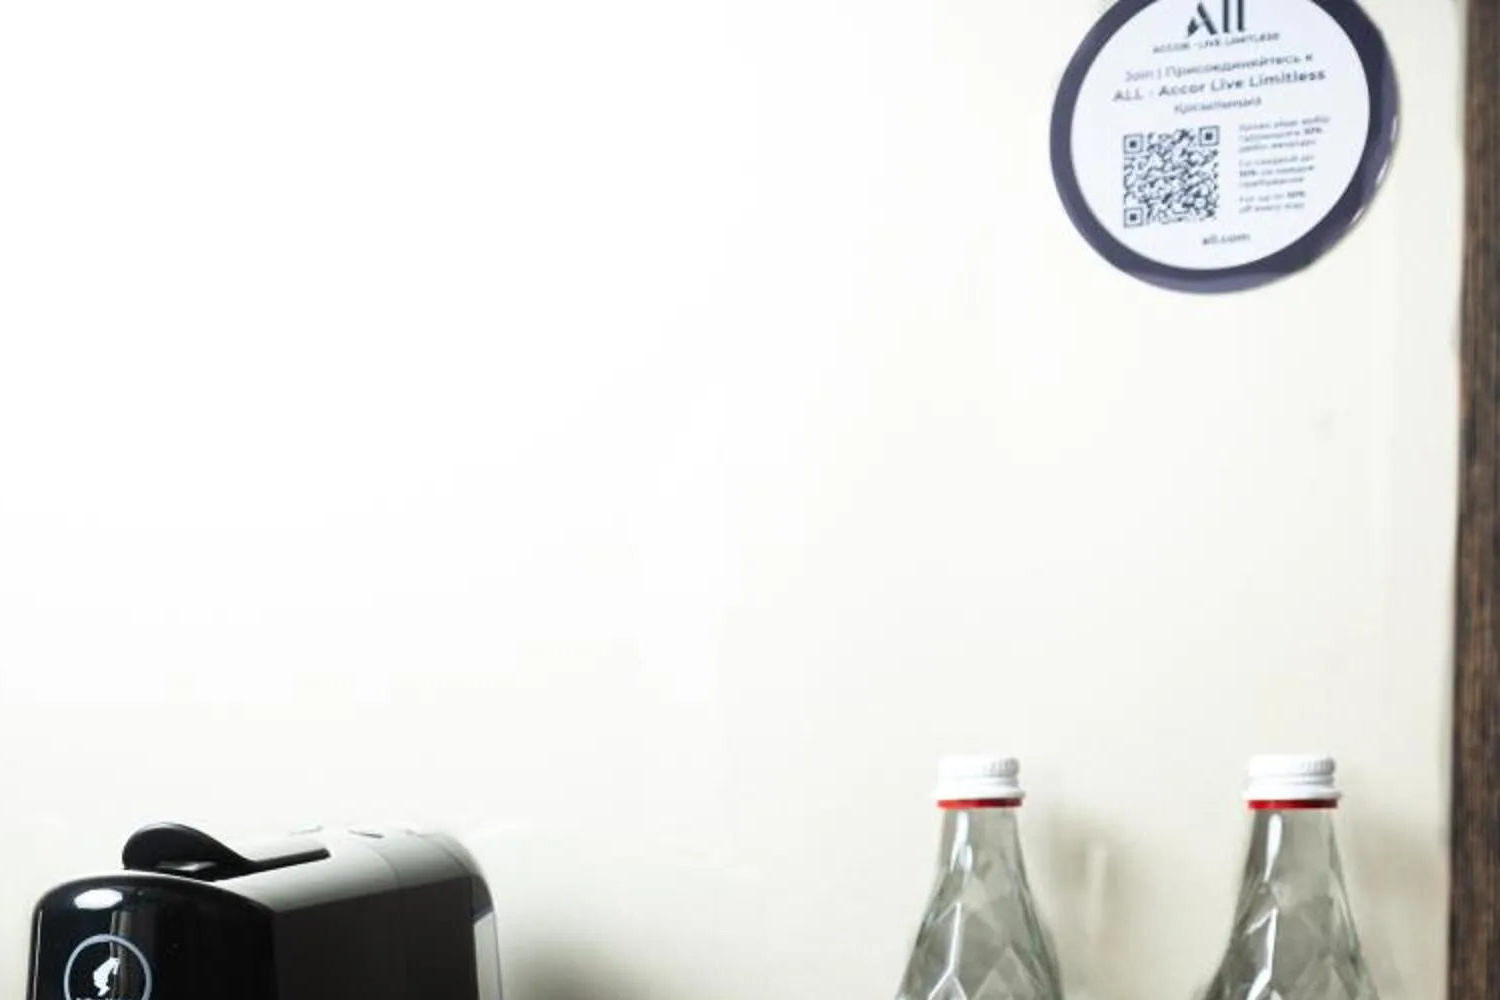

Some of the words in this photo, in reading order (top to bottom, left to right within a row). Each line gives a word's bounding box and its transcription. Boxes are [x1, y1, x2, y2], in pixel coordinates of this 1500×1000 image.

[1112, 88, 1144, 102] ALL
[1158, 82, 1206, 97] Accor
[1211, 77, 1243, 92] Live
[1249, 69, 1326, 88] Limitless
